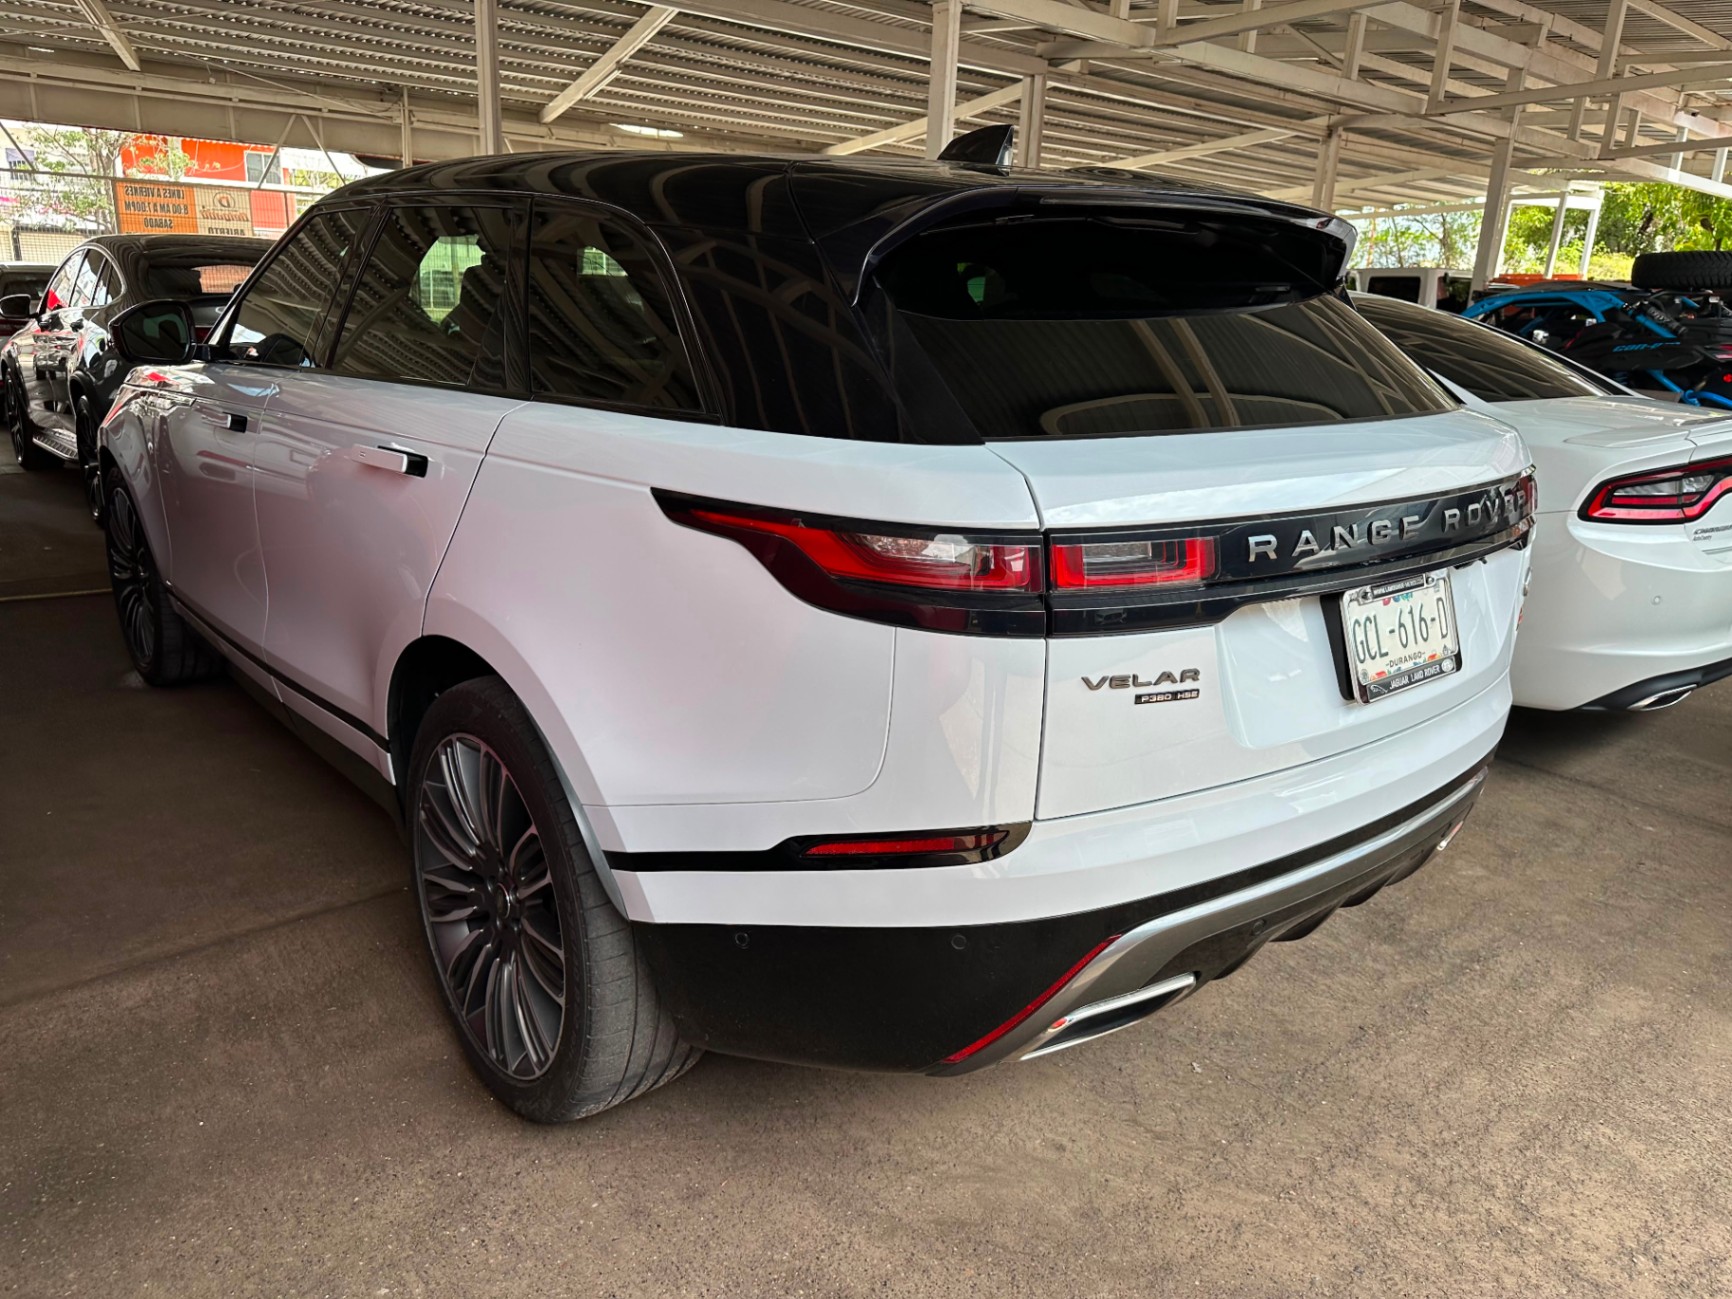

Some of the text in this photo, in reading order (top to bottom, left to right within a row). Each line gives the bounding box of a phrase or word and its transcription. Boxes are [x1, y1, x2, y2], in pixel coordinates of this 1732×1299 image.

[1248, 489, 1527, 562] RANGE ROVER
[1352, 597, 1449, 664] GCL-616-D
[1081, 668, 1200, 691] VELAR
[1389, 665, 1441, 690] JAGUAR LAND ROVER
[1141, 690, 1198, 703] P380 HSE
